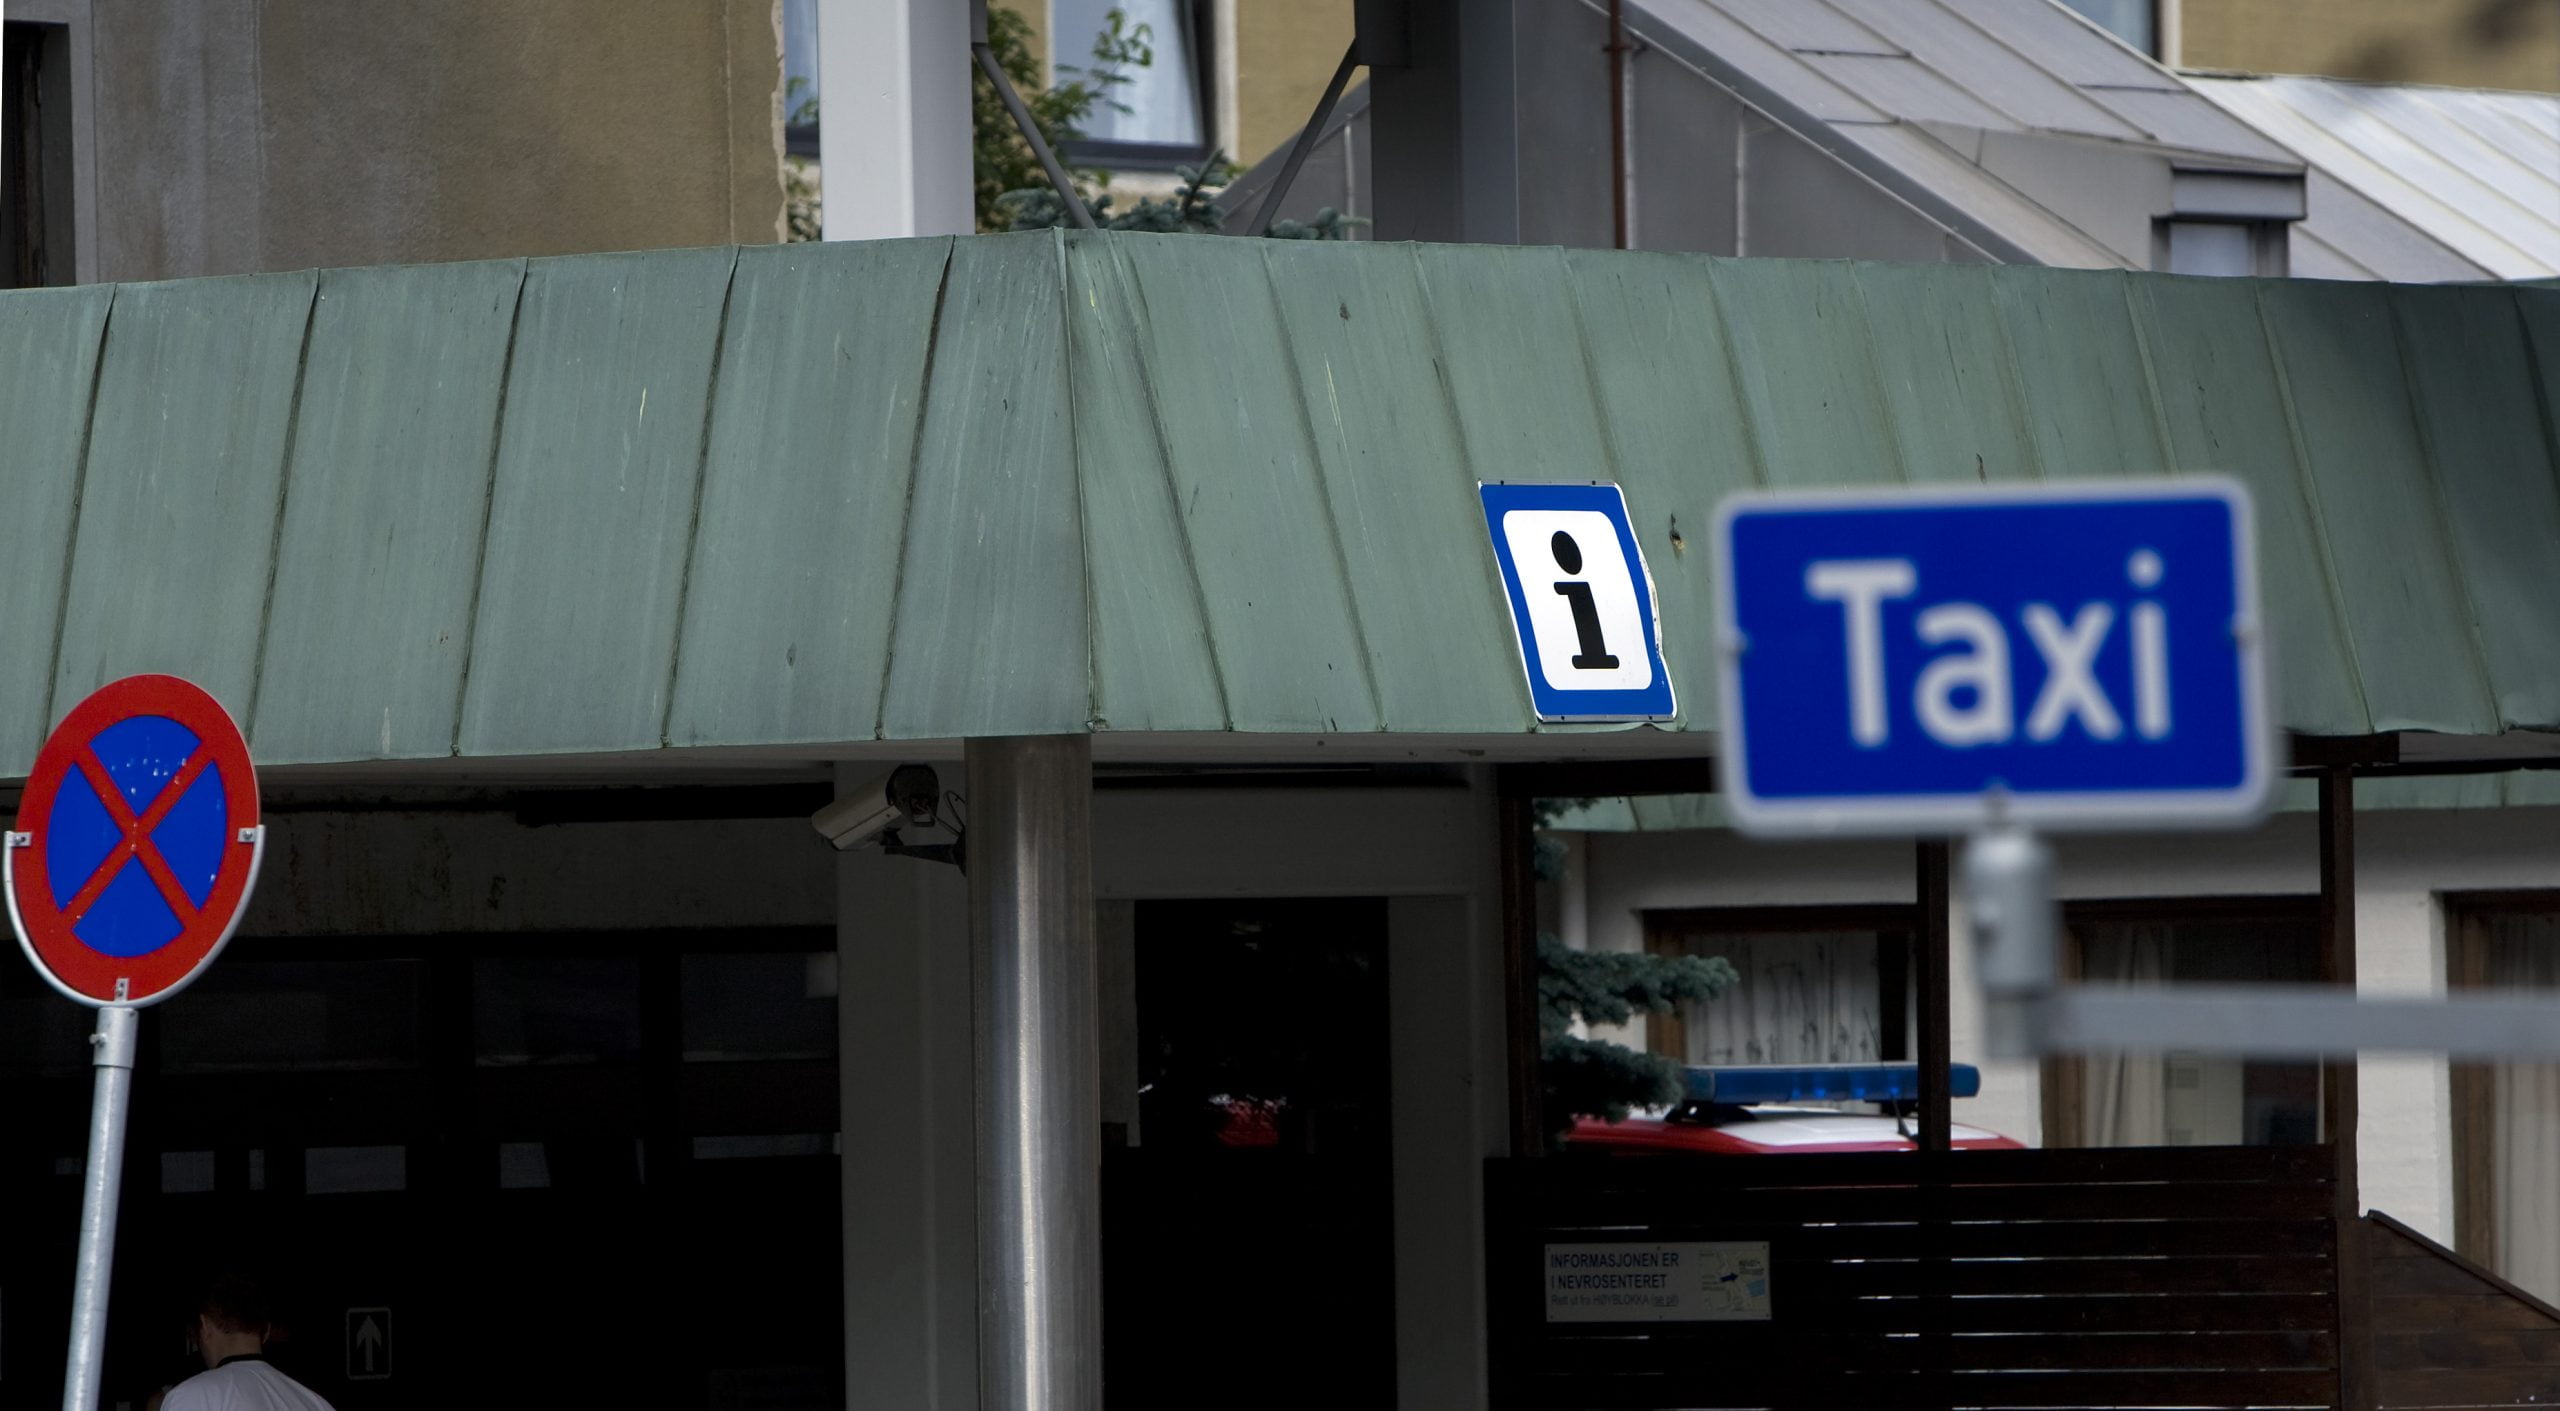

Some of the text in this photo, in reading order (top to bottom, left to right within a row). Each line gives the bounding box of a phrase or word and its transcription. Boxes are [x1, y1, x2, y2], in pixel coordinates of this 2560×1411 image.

[1550, 529, 1620, 670] i
[1805, 549, 2173, 749] Taxi
[1551, 1252, 1658, 1268] INFORMASJONEN
[1662, 1252, 1680, 1267] ER
[1558, 1274, 1667, 1289] NEVROSENTERET
